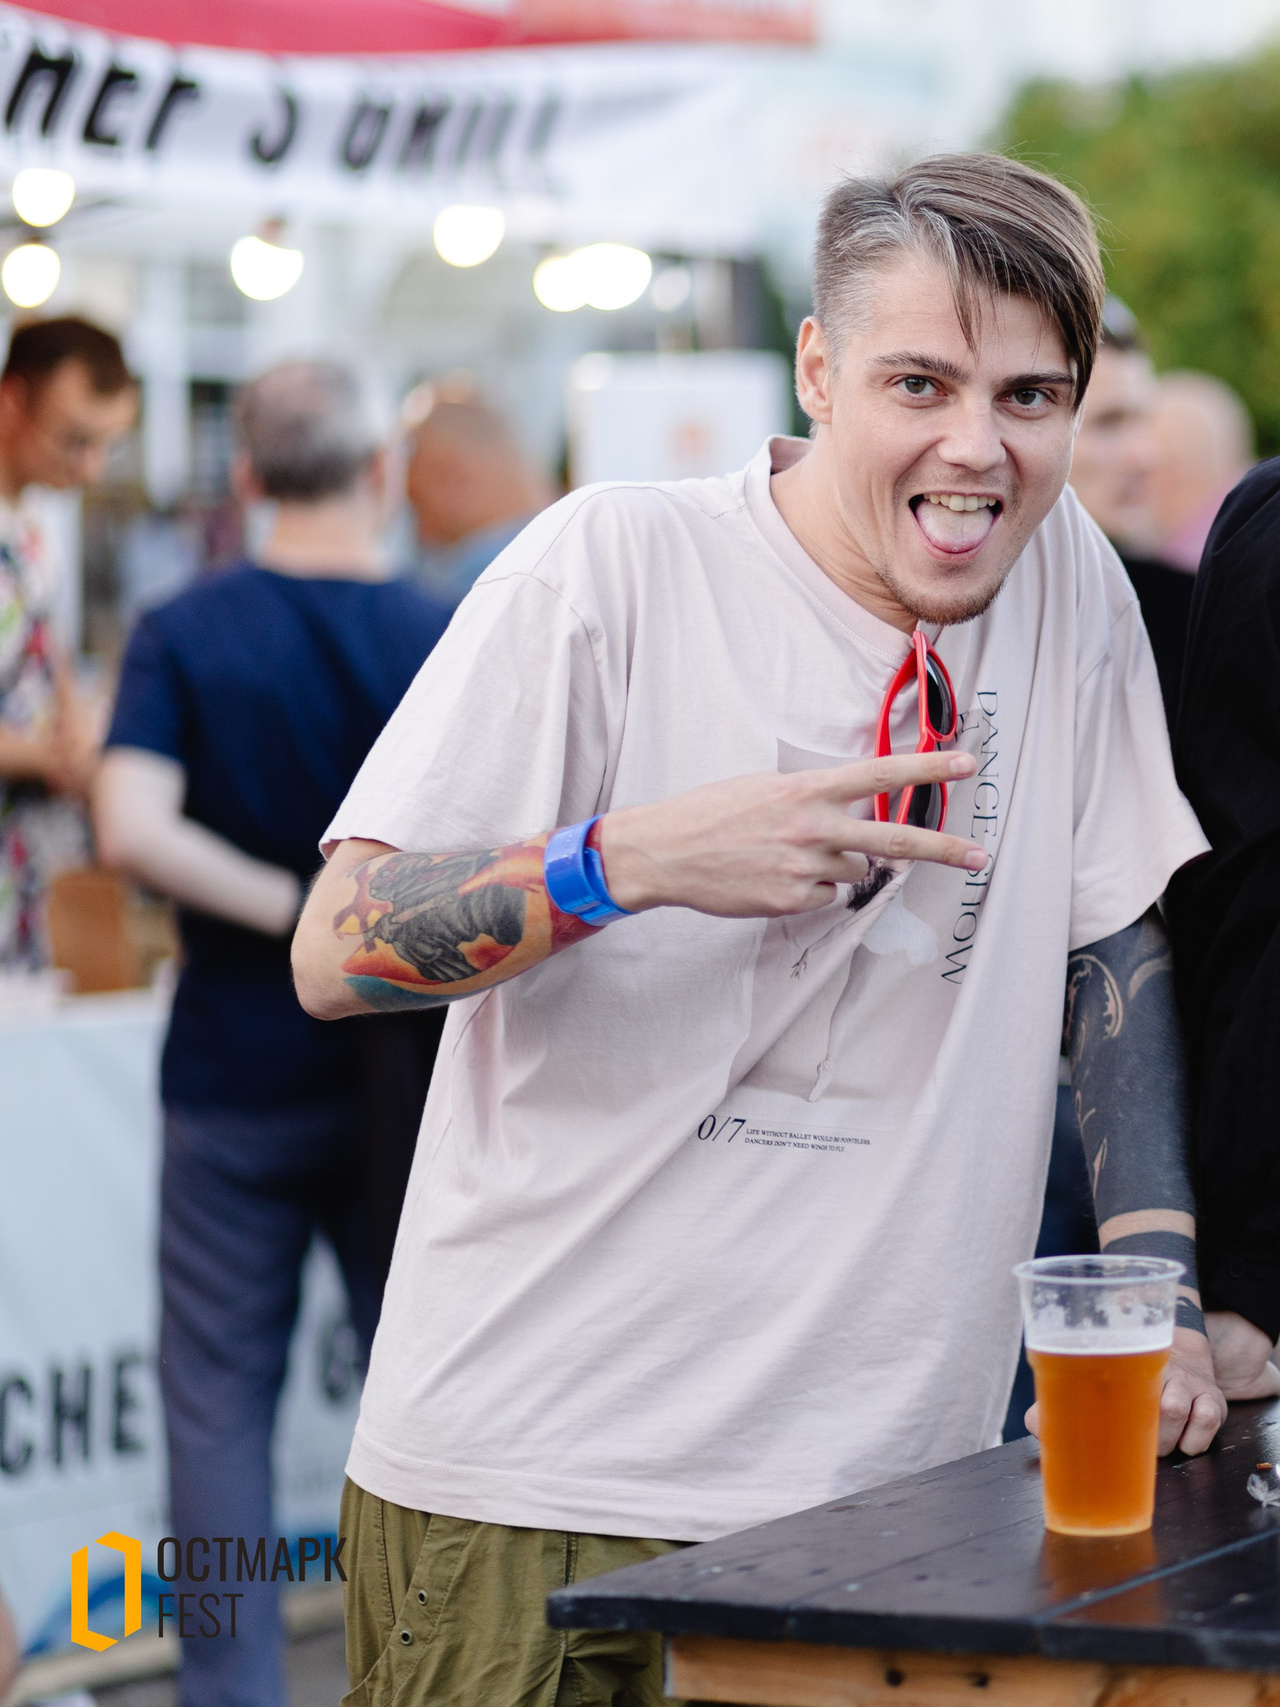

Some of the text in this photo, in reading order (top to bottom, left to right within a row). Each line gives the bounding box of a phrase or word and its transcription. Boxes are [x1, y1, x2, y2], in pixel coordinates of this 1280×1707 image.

[971, 690, 999, 838] DANCE
[744, 1137, 773, 1146] DANCERS
[761, 1129, 789, 1138] WITHOUT
[789, 1132, 812, 1140] BALLET
[813, 1134, 834, 1142] WOULD
